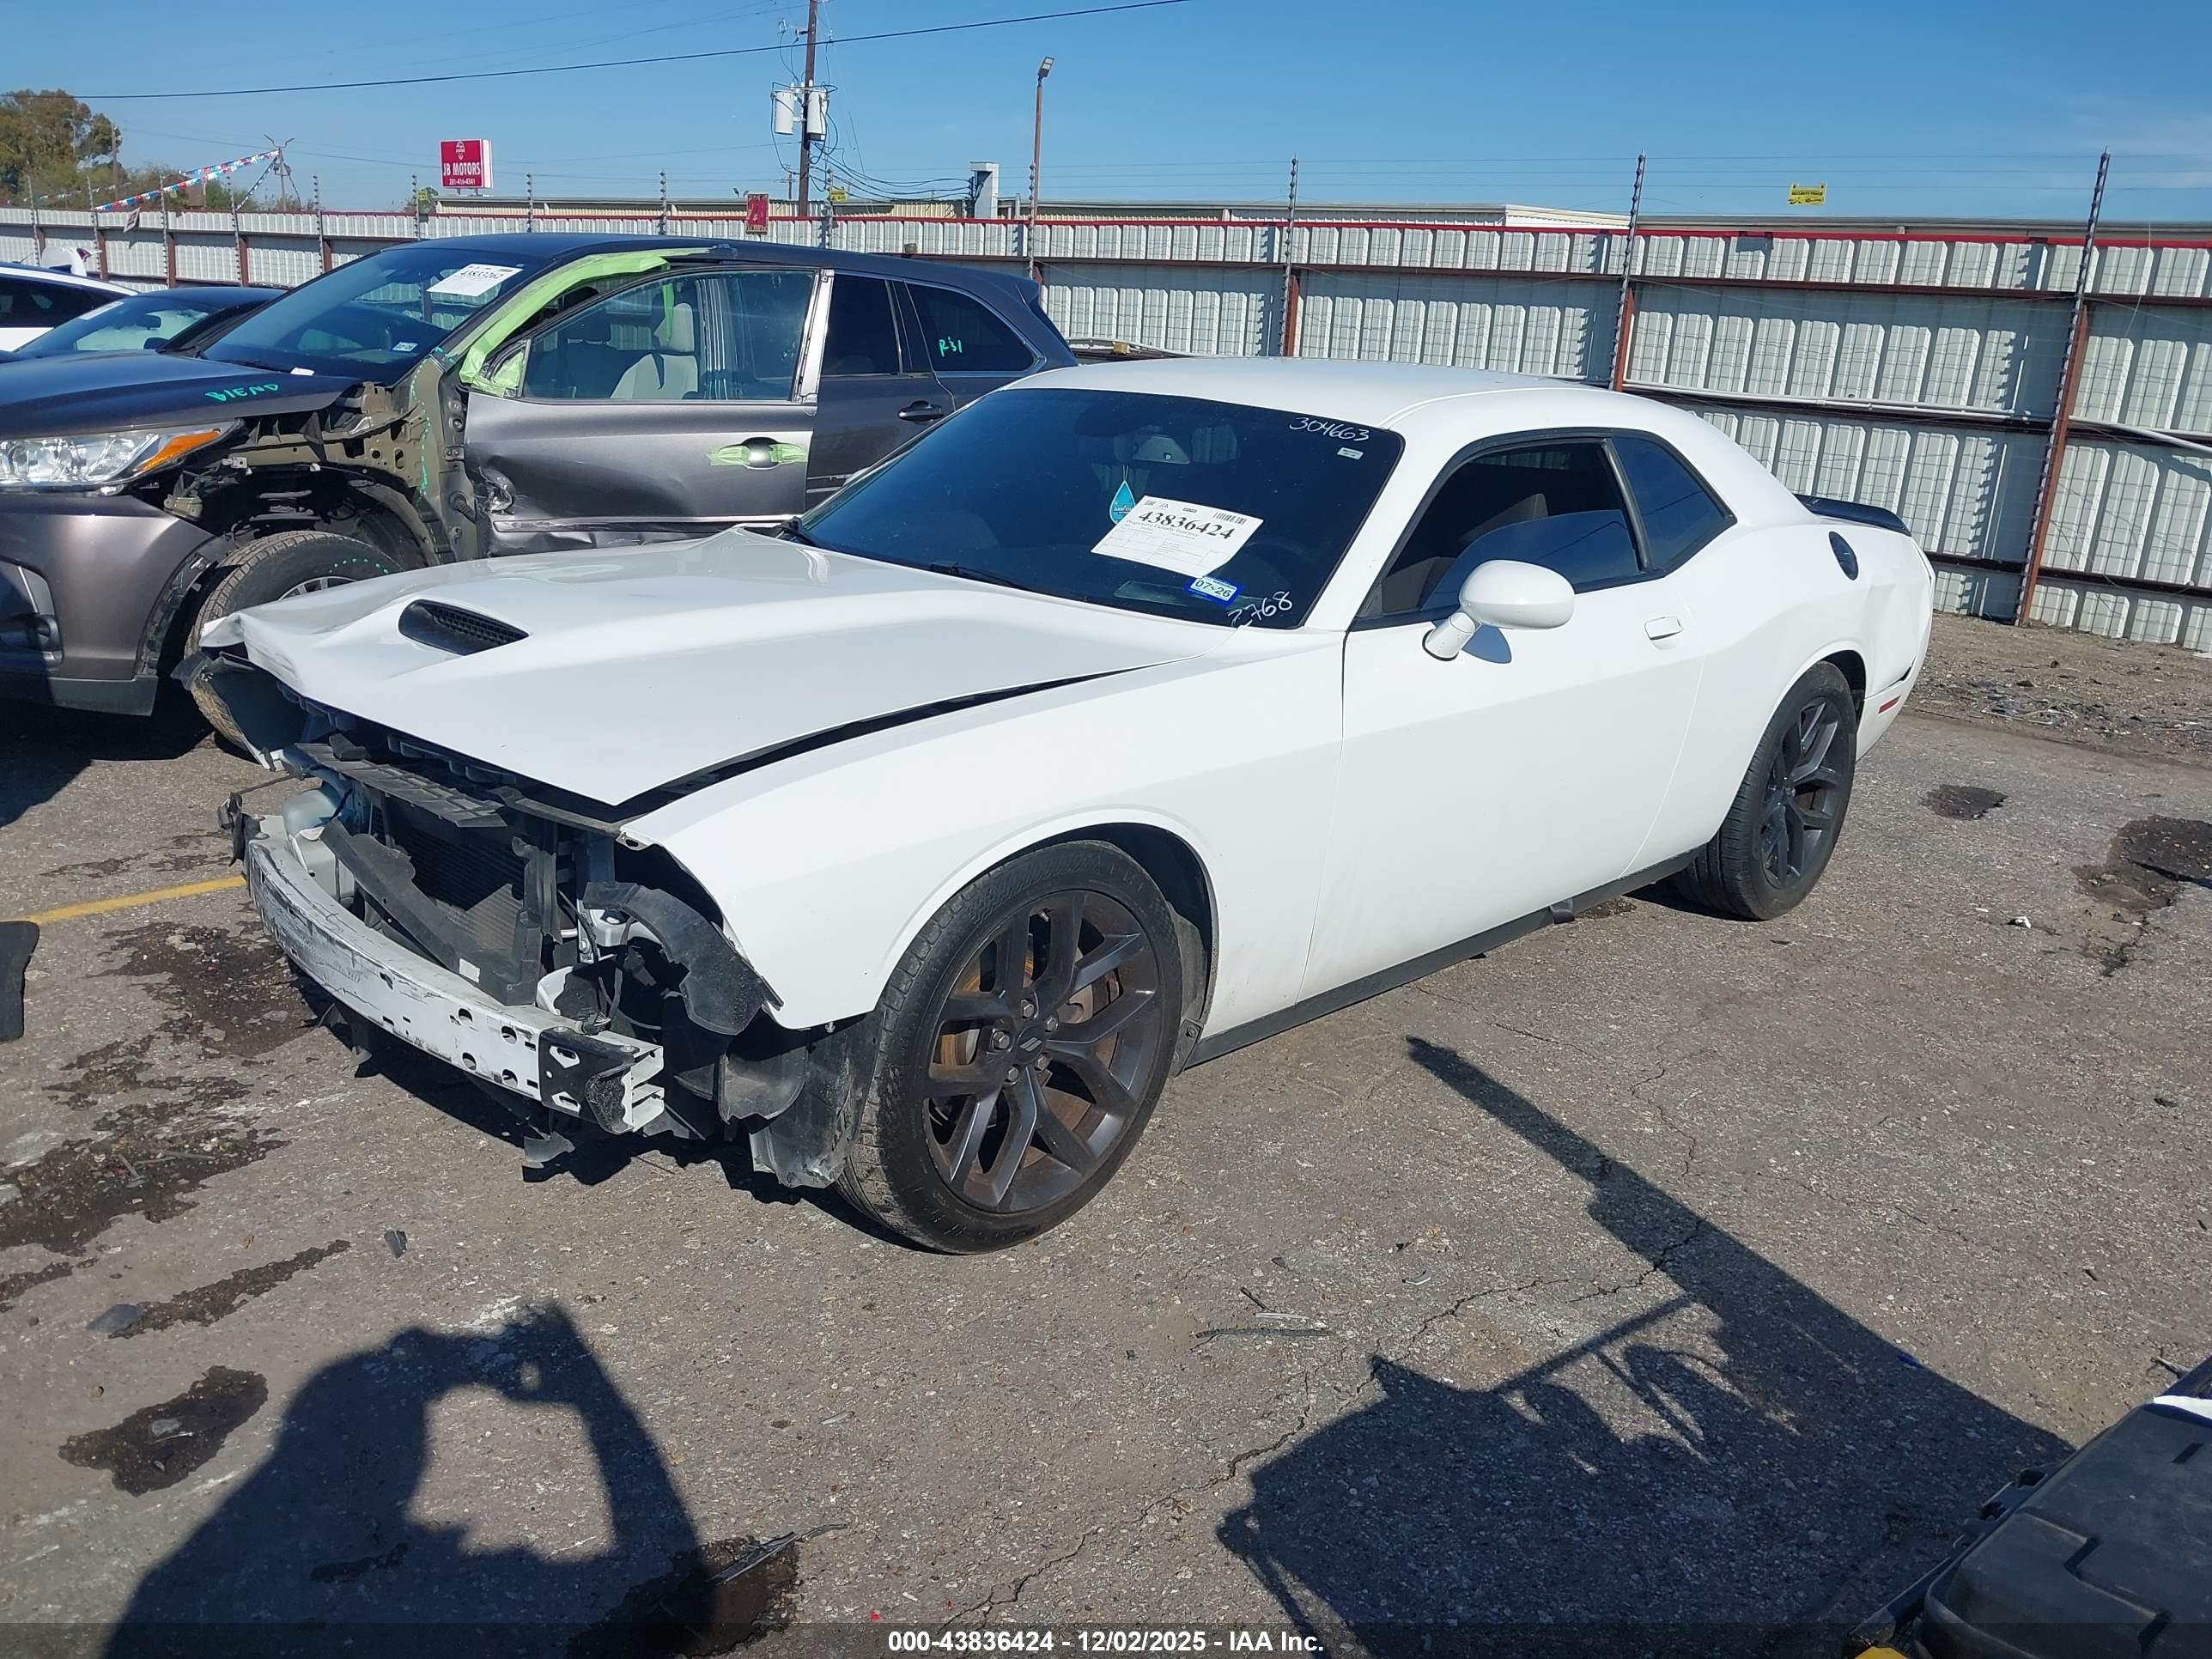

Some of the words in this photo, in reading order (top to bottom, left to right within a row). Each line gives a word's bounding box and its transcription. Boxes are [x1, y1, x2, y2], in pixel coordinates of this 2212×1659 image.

[443, 162, 451, 176] JB
[453, 161, 481, 176] MOTORS
[1289, 416, 1370, 441] 304663
[1138, 511, 1235, 539] 43836424
[1194, 580, 1212, 589] 07
[1214, 587, 1232, 599] 26
